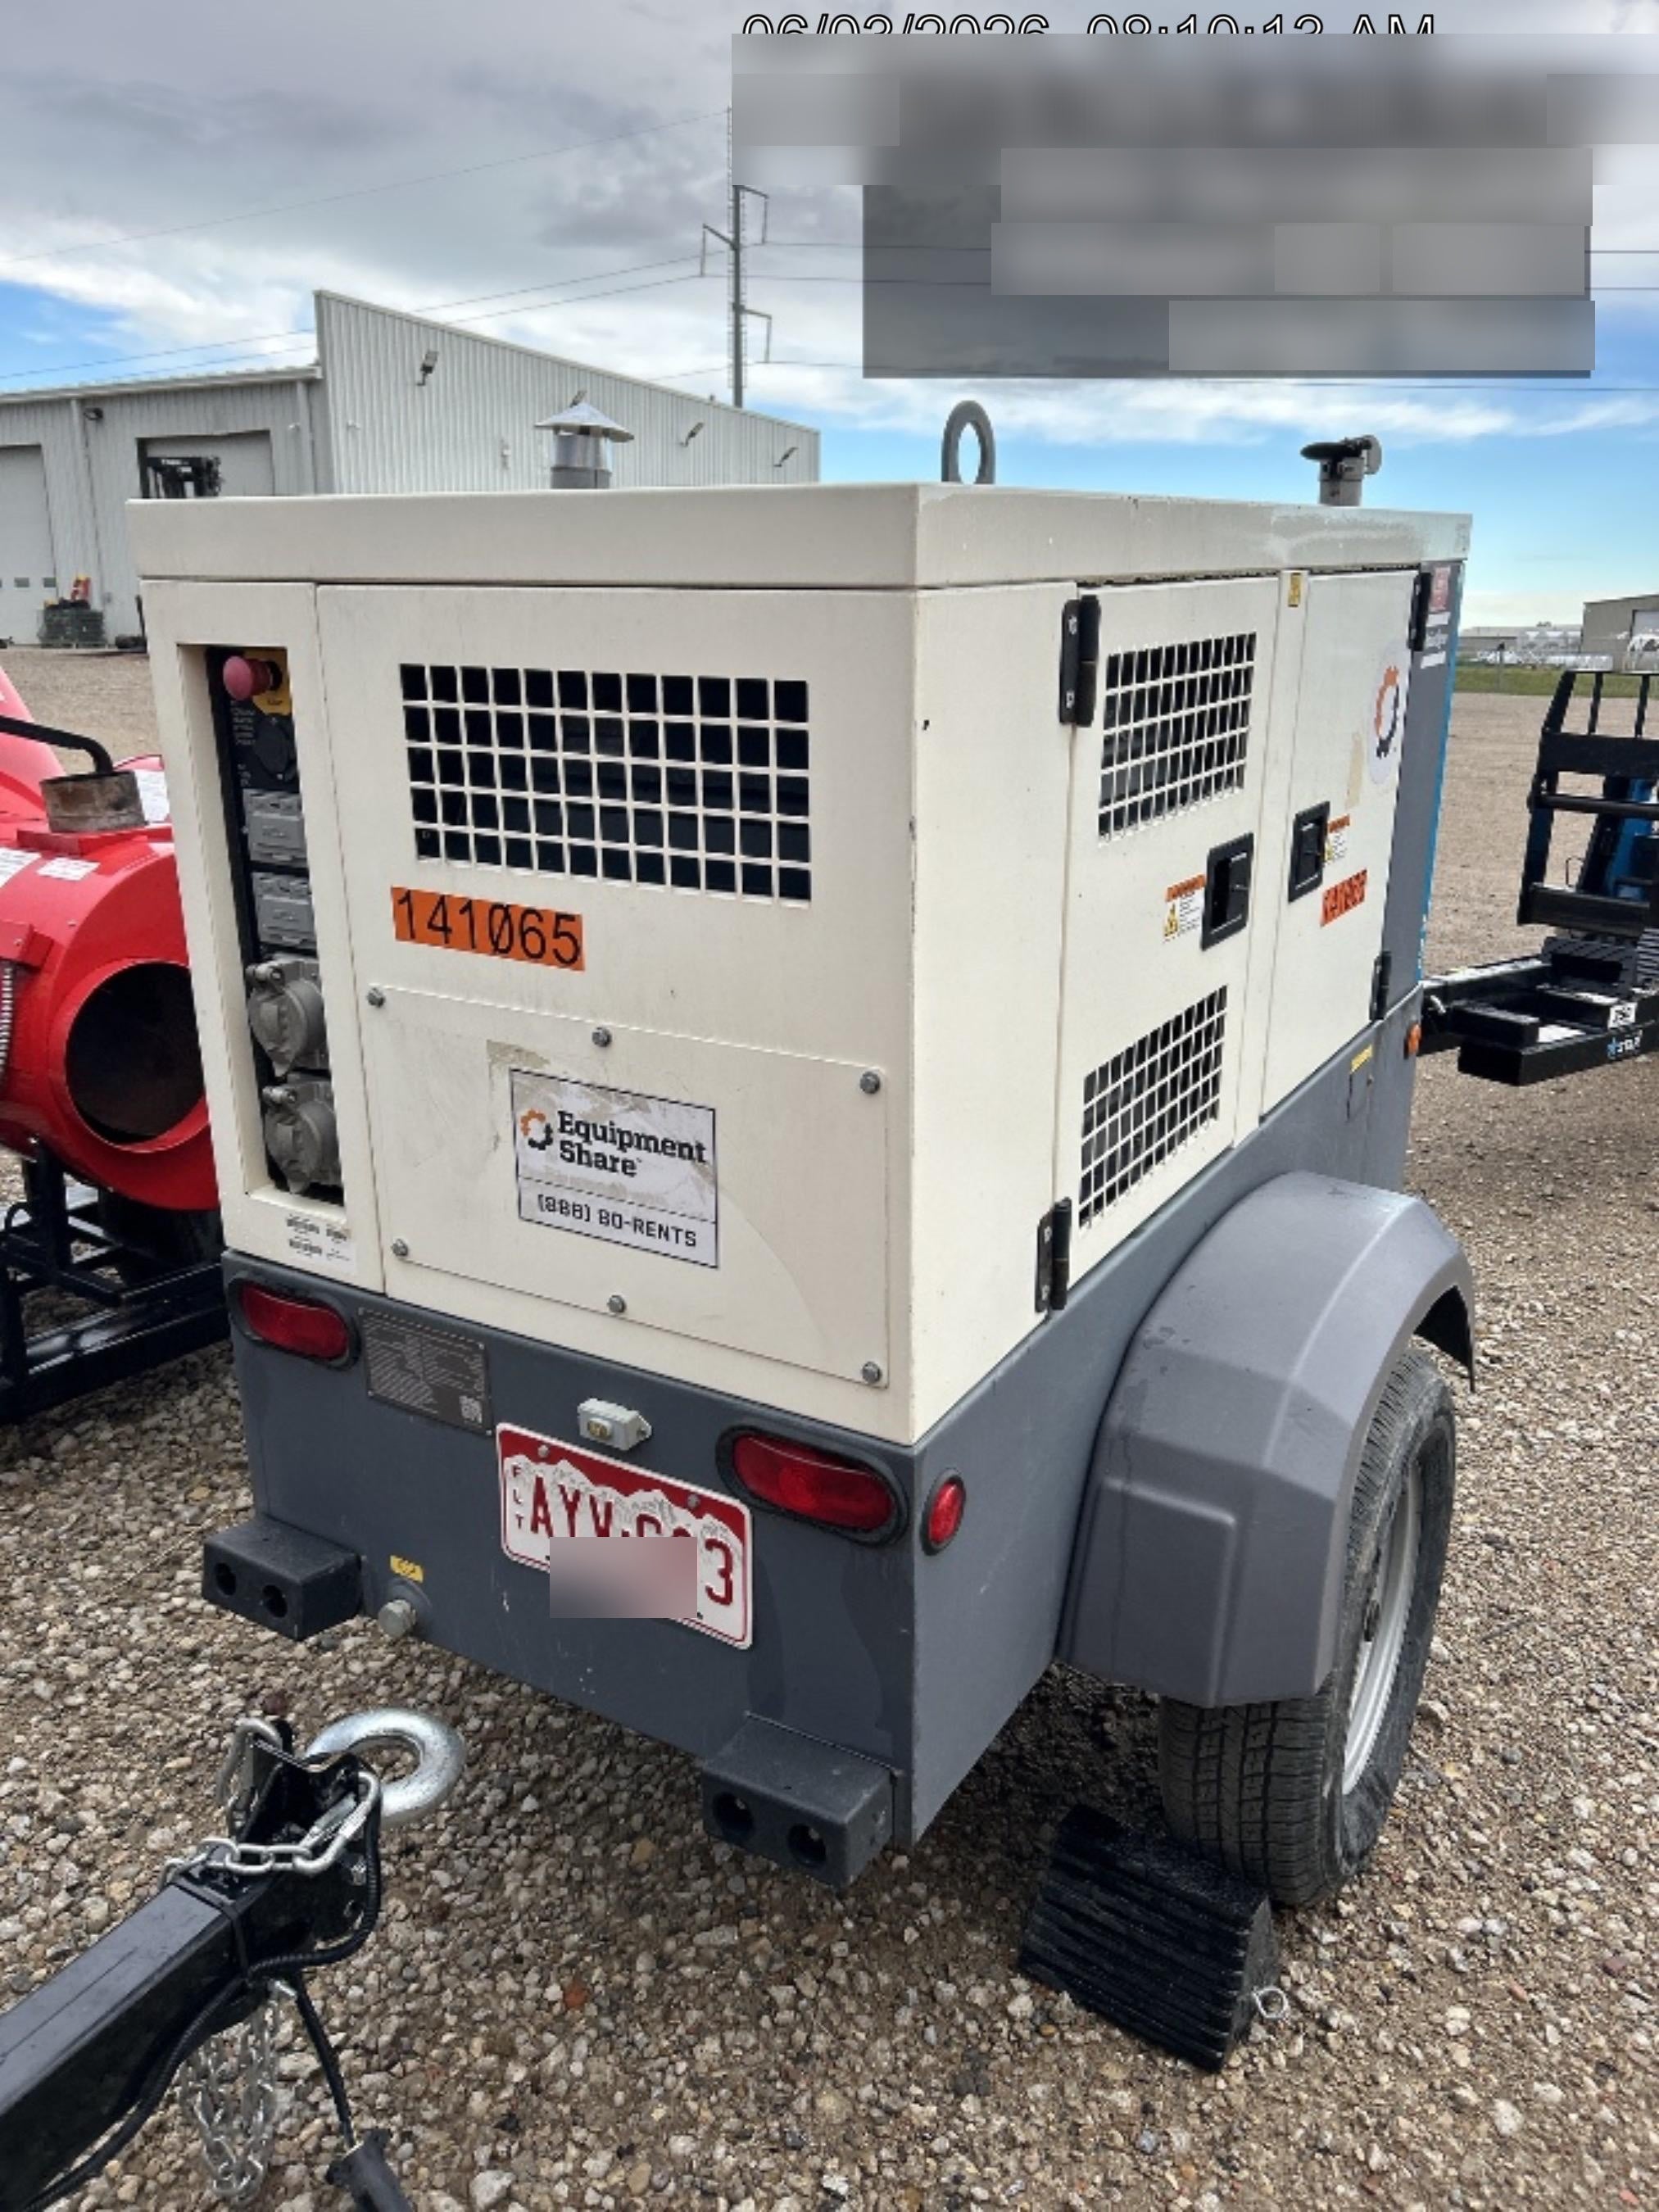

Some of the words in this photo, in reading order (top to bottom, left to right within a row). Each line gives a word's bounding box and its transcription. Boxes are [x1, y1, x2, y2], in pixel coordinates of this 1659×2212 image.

[397, 889, 582, 966] 141065
[558, 1109, 706, 1164] Equipment
[560, 1140, 637, 1178] Share
[598, 1208, 696, 1247] 80-RENTS
